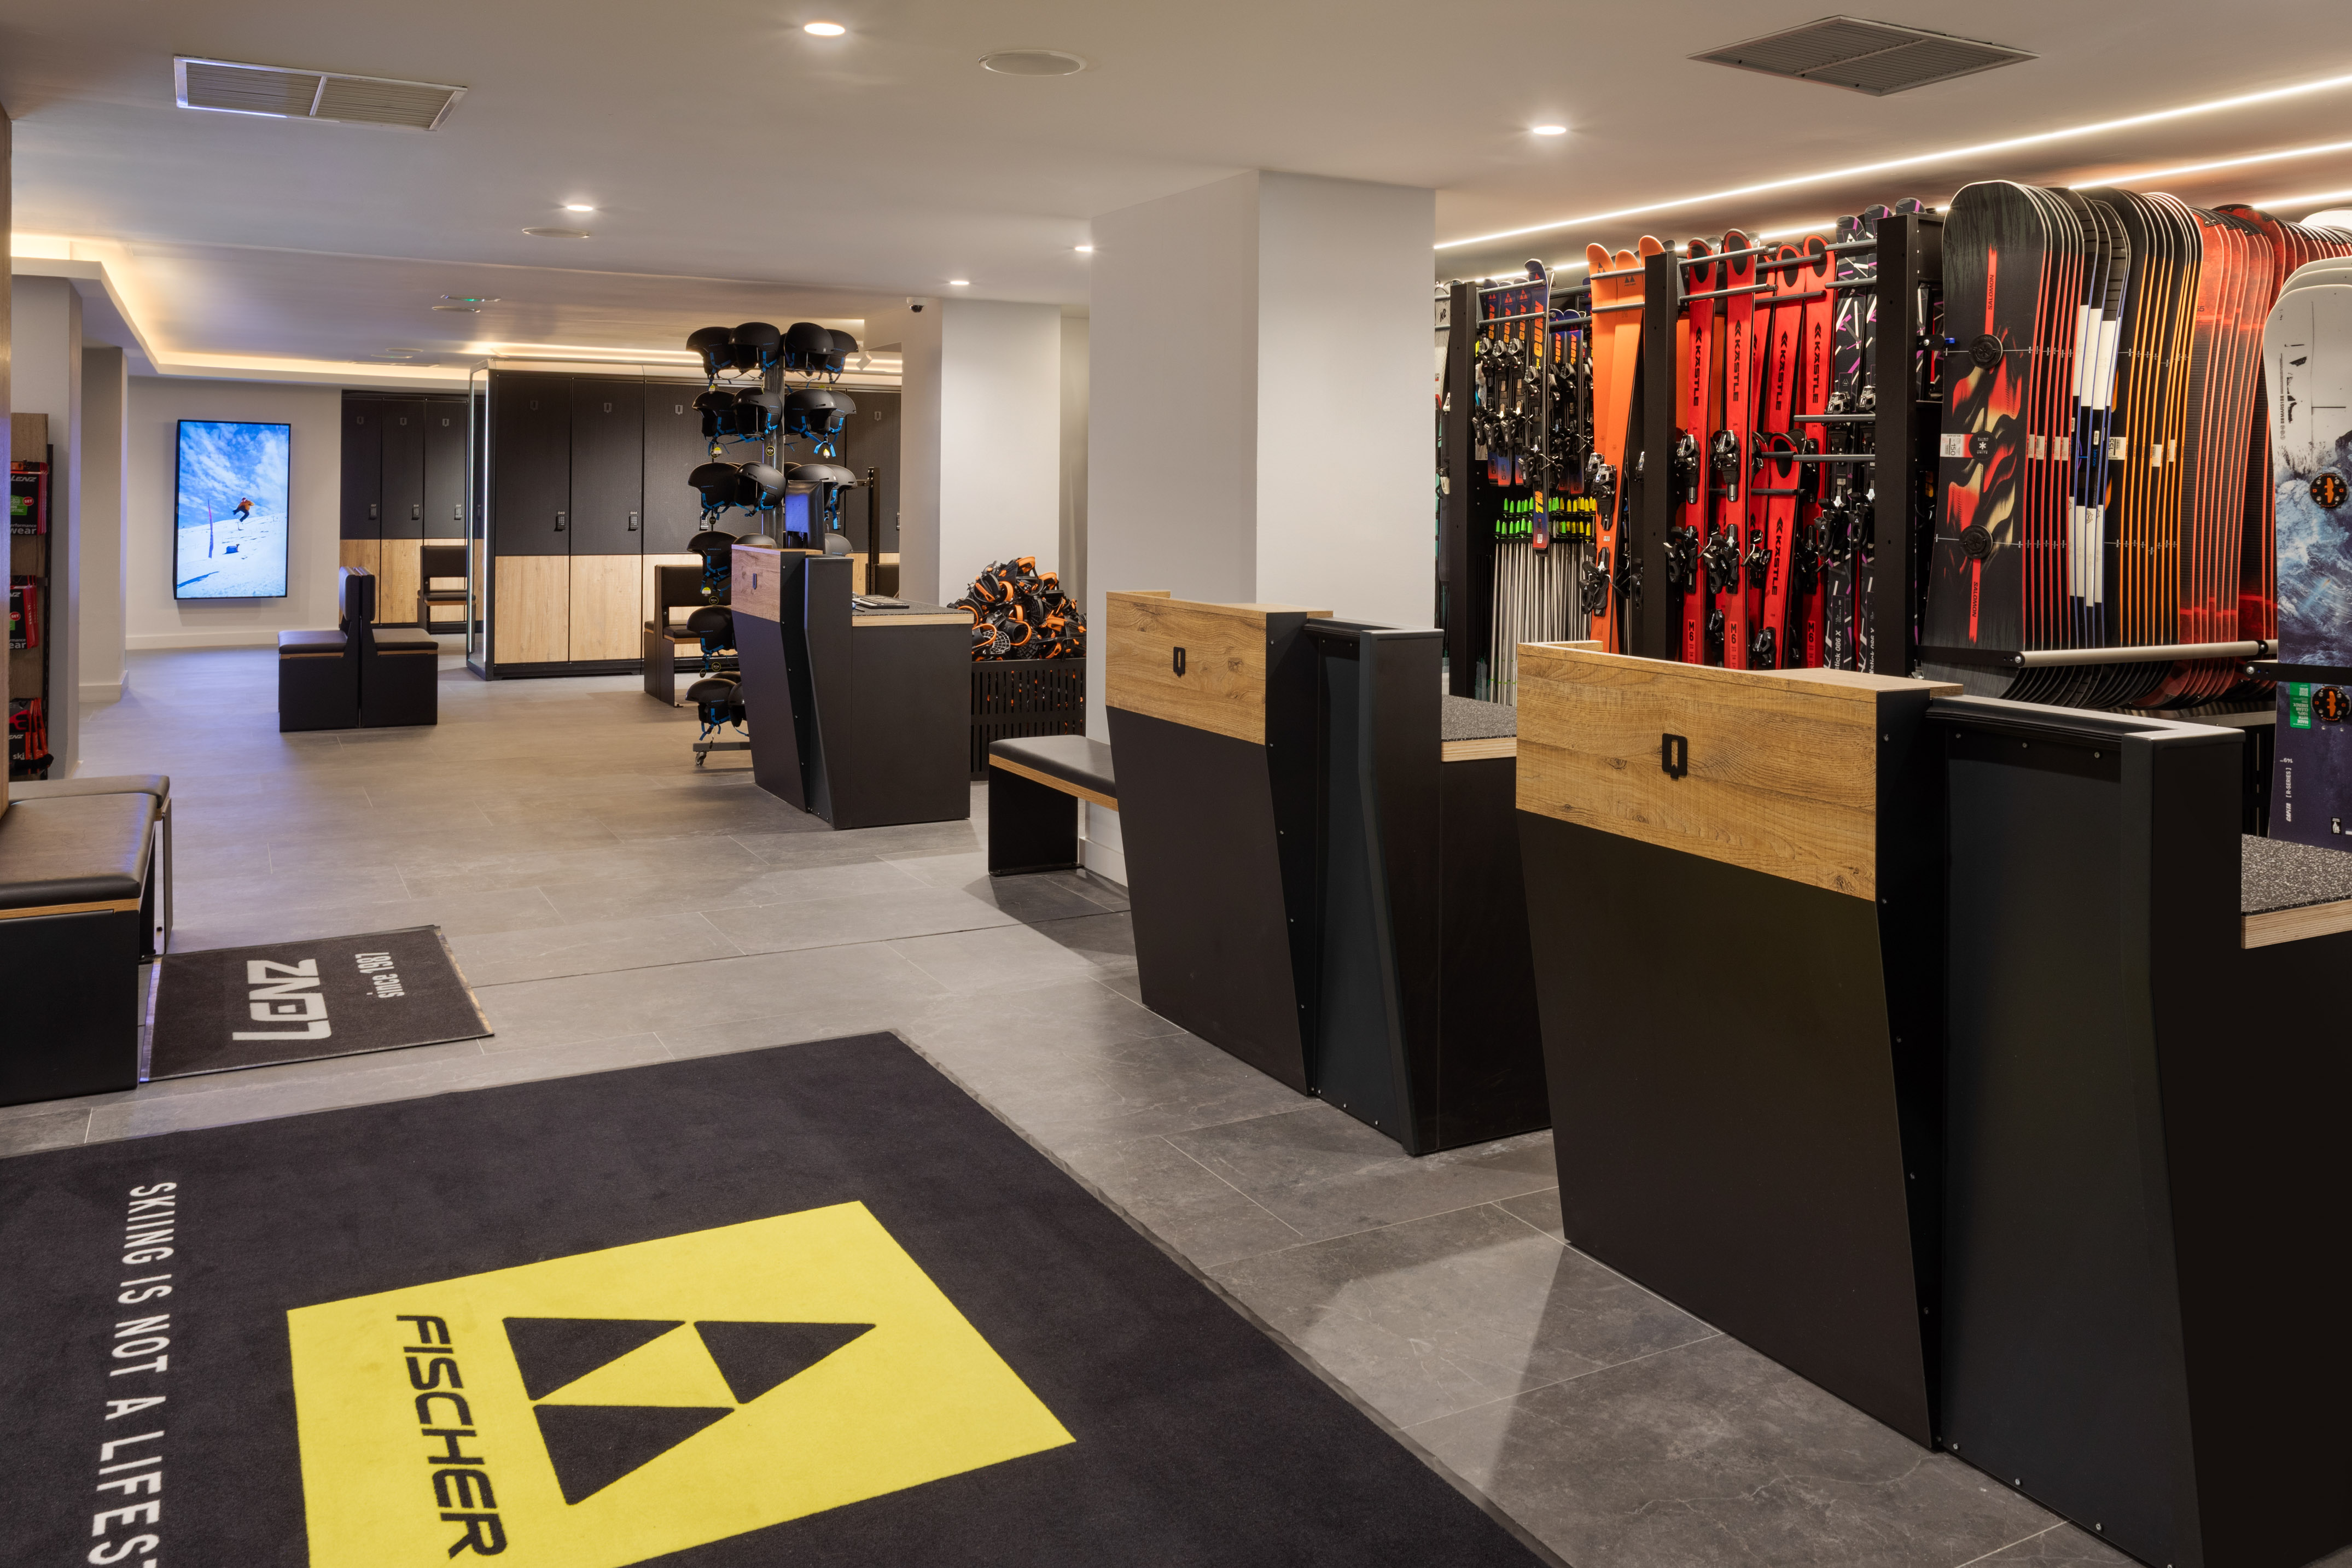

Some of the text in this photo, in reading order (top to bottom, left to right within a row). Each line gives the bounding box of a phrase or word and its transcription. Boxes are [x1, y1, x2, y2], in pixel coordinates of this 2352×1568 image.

[1440, 308, 1446, 323] K2
[1534, 300, 1544, 357] CURV
[354, 952, 394, 974] 1987
[232, 958, 332, 1041] LENZ
[88, 1182, 177, 1568] SKIING IS NOT A LIFES
[396, 1315, 508, 1560] FISCHER
